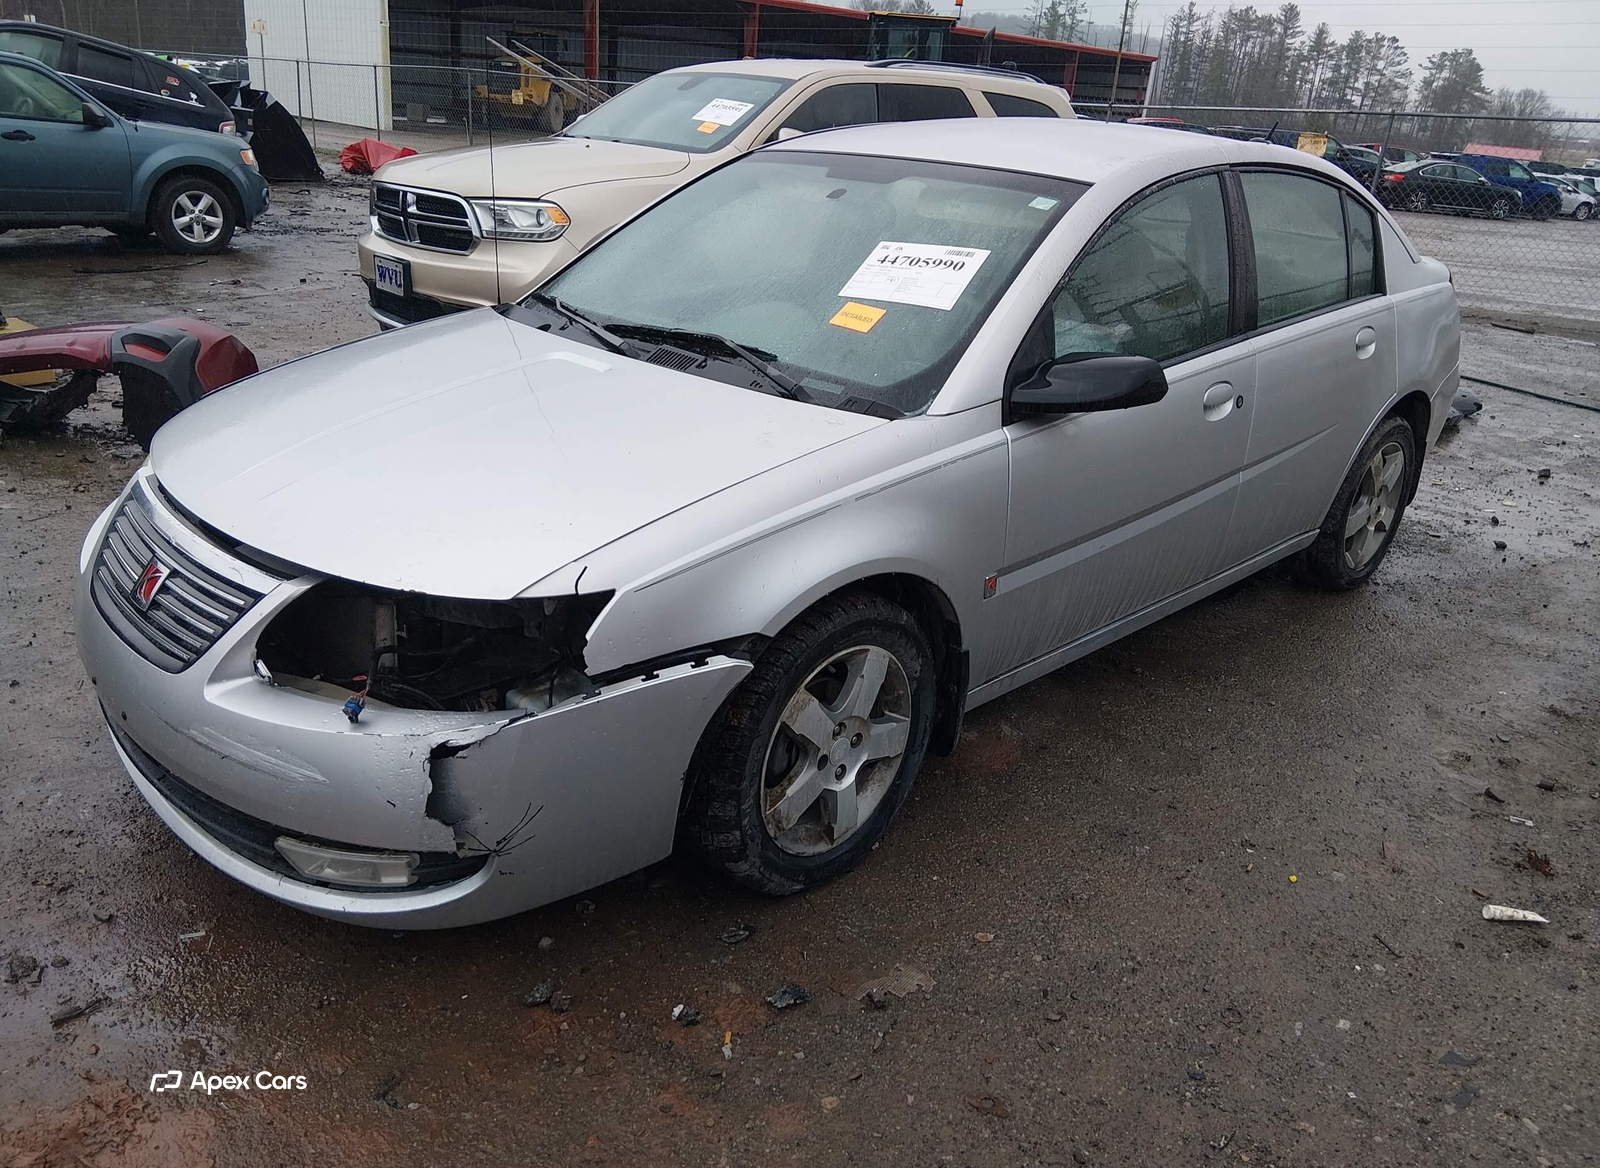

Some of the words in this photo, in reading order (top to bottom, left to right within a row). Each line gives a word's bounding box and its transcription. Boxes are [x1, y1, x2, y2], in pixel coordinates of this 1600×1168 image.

[877, 254, 966, 272] 44705990
[376, 263, 403, 289] WVU
[840, 311, 873, 323] DETAILED
